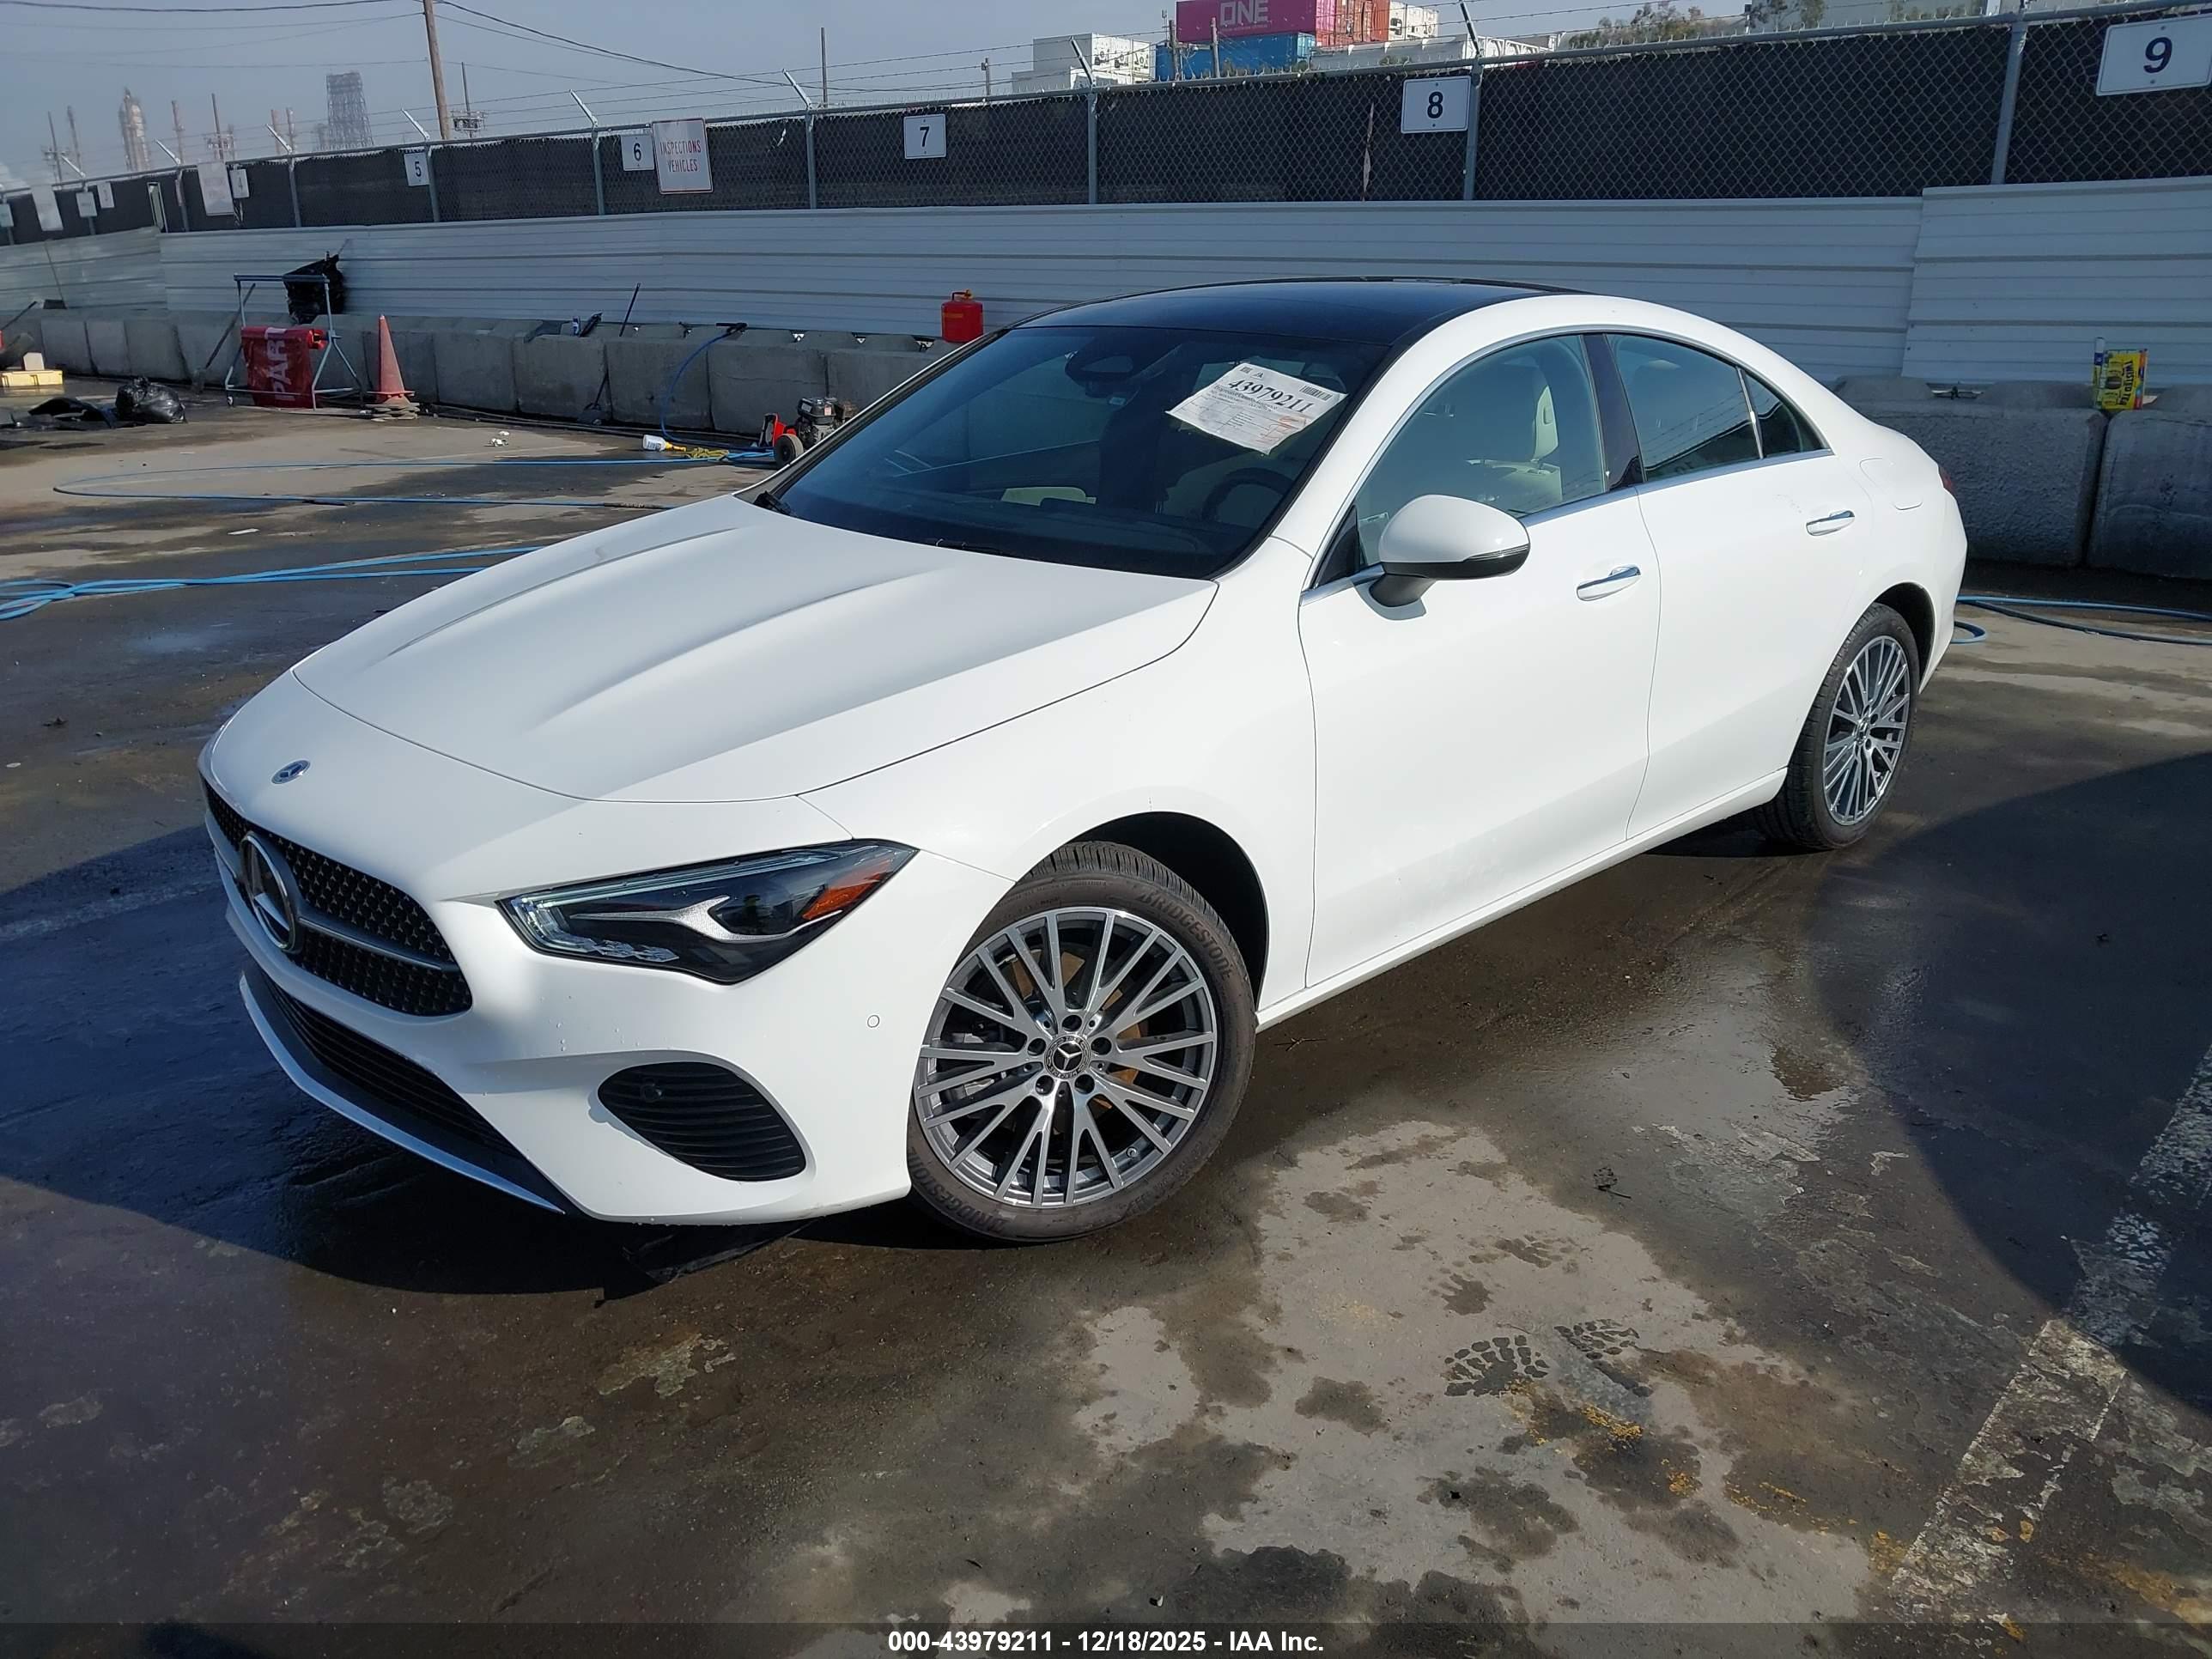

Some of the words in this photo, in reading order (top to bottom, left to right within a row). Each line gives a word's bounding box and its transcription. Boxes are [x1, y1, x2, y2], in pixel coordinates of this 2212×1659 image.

[1220, 0, 1268, 26] ONE
[2143, 37, 2172, 74] 9
[1427, 91, 1443, 118] 8
[659, 139, 702, 155] INSPECTIONS
[920, 126, 929, 147] 7
[634, 143, 641, 161] 6
[415, 161, 422, 177] 5
[667, 158, 698, 173] VEHICLES
[2123, 360, 2134, 392] TWISTED
[1228, 380, 1315, 413] 43979211
[2117, 393, 2131, 405] TEA
[1134, 893, 1233, 979] BRIDGESTONE
